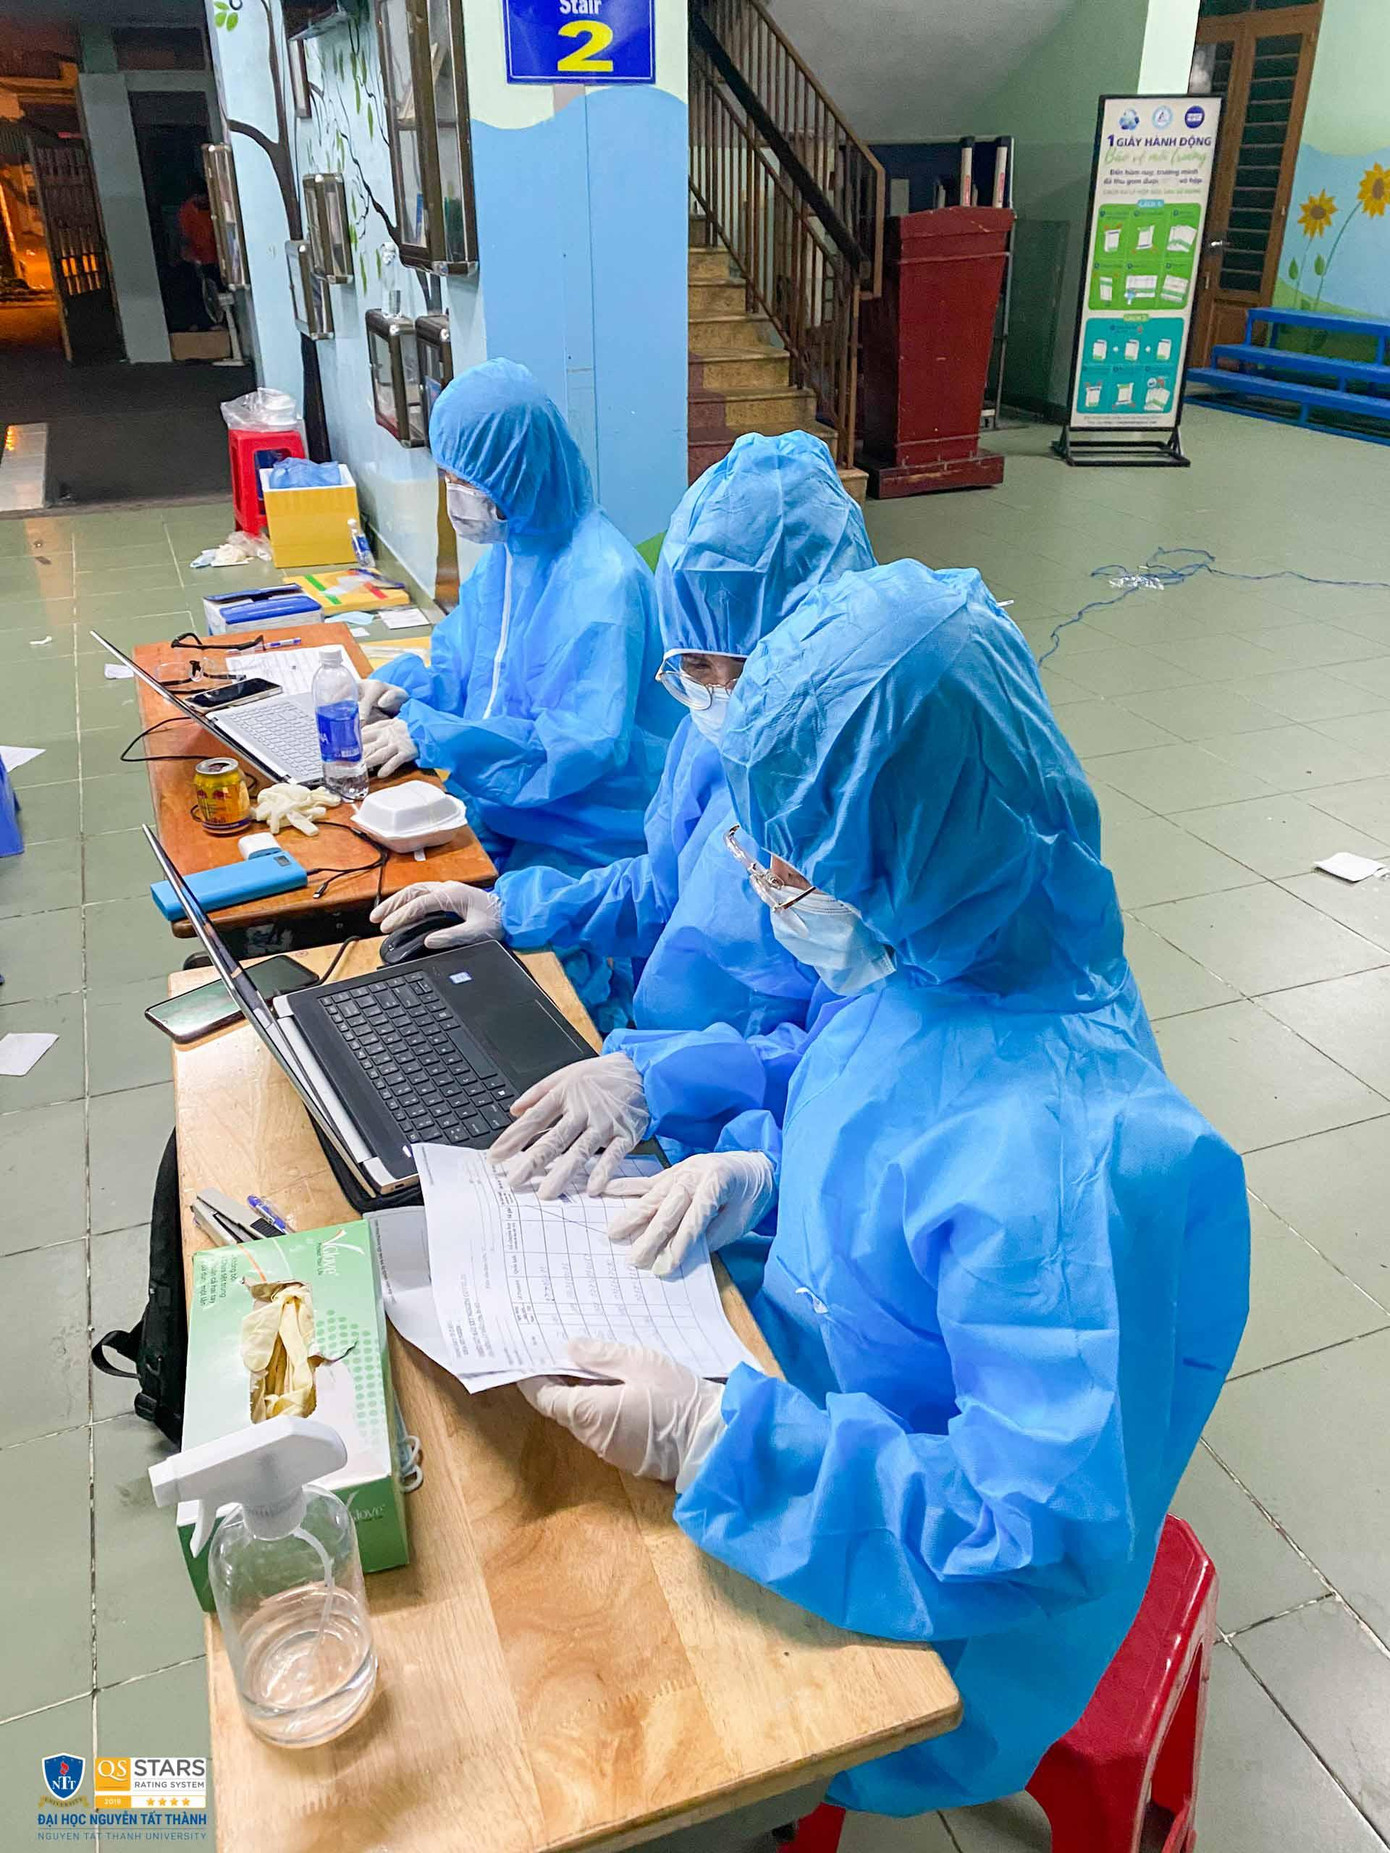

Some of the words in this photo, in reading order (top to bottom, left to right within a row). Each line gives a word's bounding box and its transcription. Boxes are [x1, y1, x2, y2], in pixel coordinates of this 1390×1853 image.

[560, 0, 601, 14] Stair
[557, 20, 613, 72] 2
[1107, 134, 1115, 147] 1
